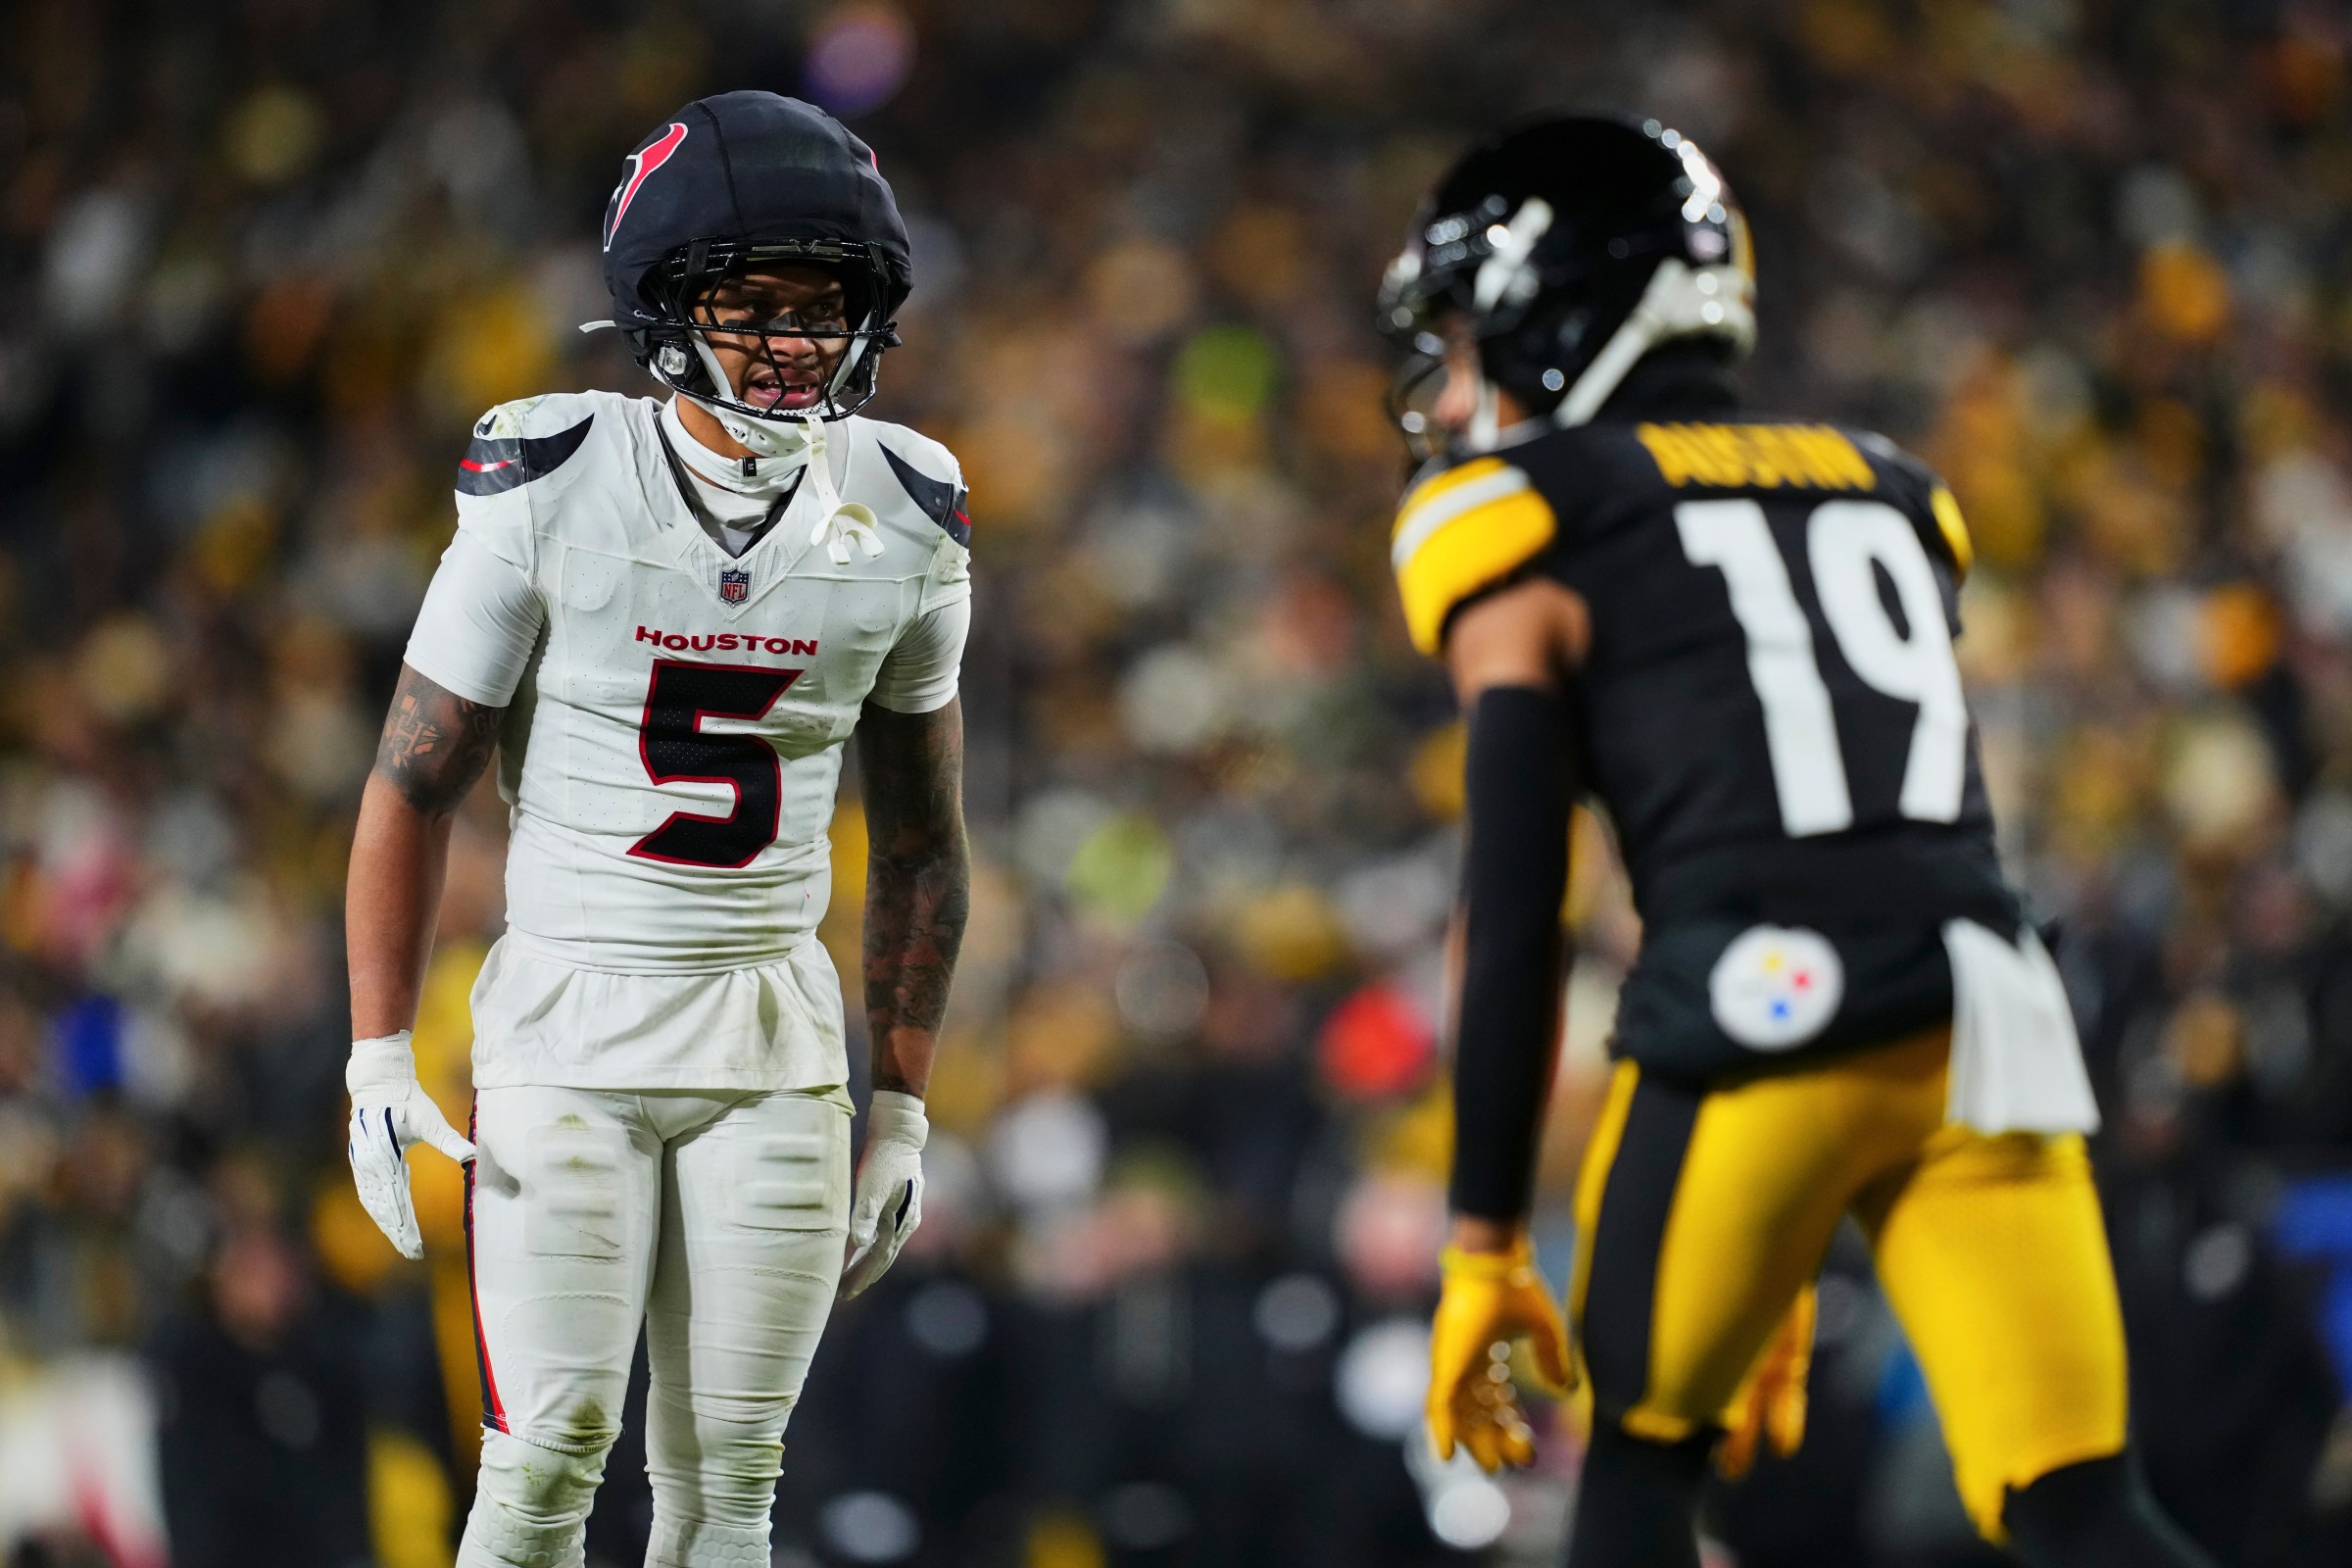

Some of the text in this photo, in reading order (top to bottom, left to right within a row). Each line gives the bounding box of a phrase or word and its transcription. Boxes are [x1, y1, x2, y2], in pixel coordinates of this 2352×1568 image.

[635, 625, 818, 656] HOUSTON
[723, 583, 745, 600] NFL
[1674, 498, 1968, 838] 19
[626, 659, 805, 868] 5
